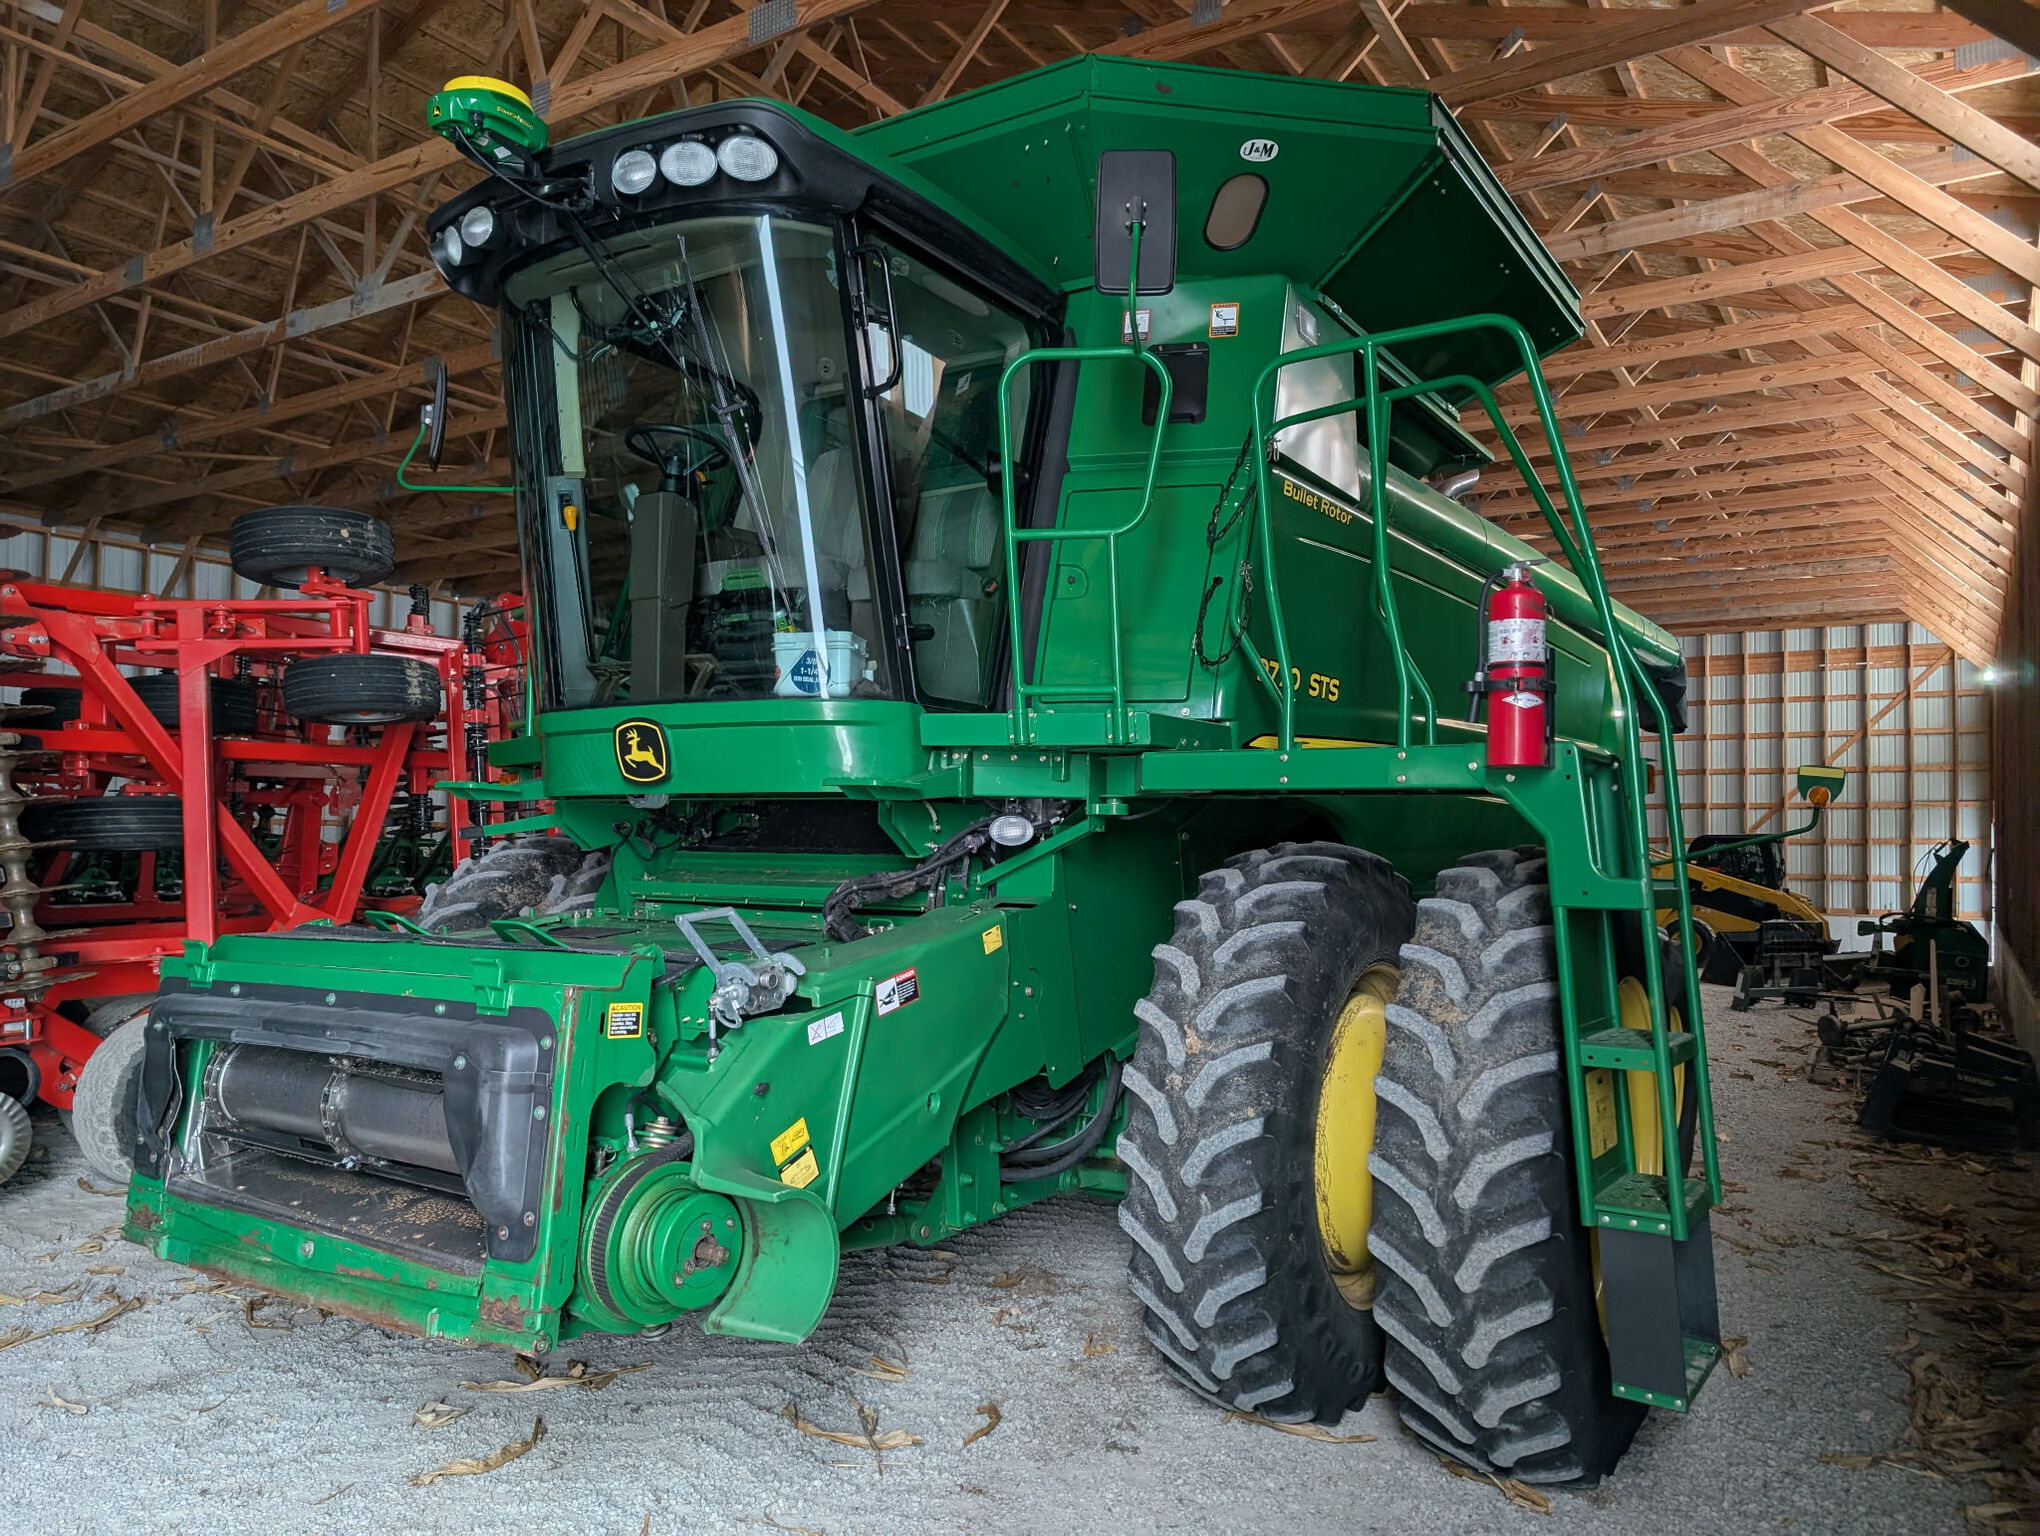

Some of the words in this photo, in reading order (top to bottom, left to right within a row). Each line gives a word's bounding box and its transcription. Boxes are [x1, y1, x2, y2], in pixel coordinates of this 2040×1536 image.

[1243, 142, 1276, 158] J&M
[1283, 479, 1318, 510] Bullet
[1320, 498, 1353, 525] Rotor
[1308, 672, 1340, 702] STS
[615, 1004, 642, 1012] CAUTION
